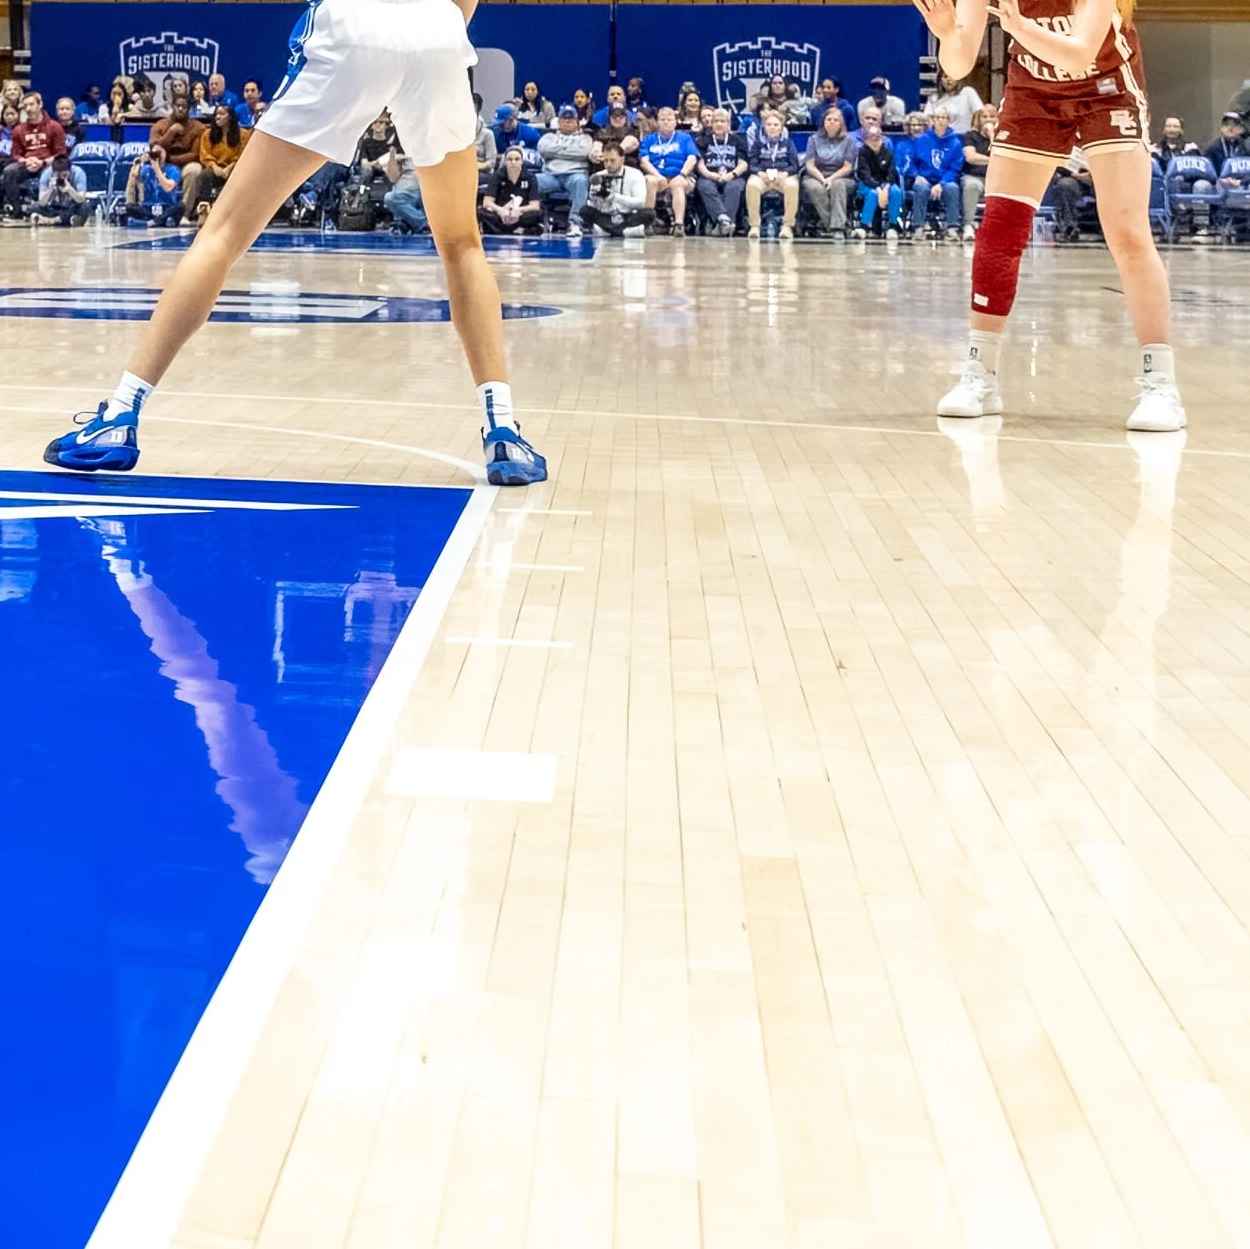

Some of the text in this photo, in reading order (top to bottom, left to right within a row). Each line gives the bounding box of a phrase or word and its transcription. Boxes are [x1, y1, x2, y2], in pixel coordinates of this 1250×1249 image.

[128, 52, 210, 76] SISTERHOOD
[722, 58, 811, 83] SISTERHOOD
[1176, 156, 1206, 173] DUKE
